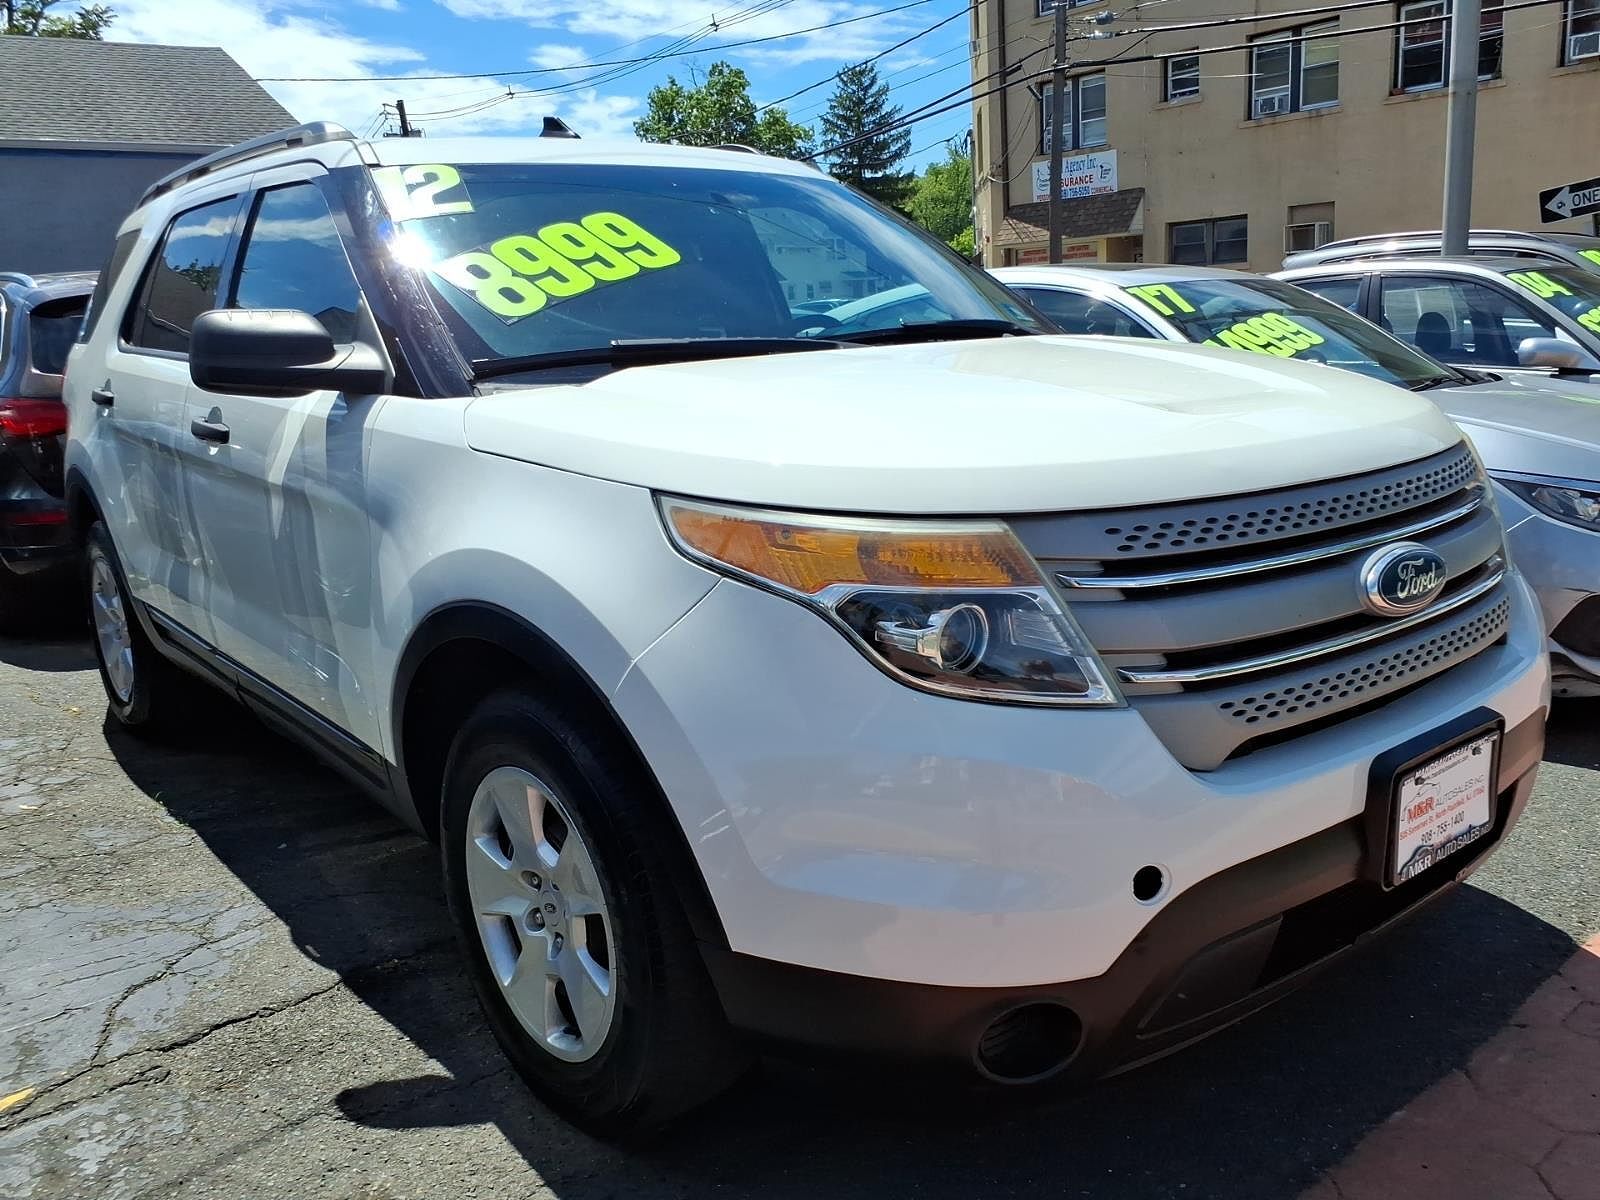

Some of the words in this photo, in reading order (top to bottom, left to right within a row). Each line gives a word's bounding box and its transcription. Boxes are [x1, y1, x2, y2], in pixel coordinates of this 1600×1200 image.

[1064, 158, 1086, 176] Agency
[1061, 174, 1094, 187] SURANCE
[1572, 188, 1600, 207] ONE
[437, 212, 681, 317] 8999
[1507, 270, 1573, 298] 04
[1203, 312, 1325, 357] 4999
[1397, 557, 1441, 599] Ford
[1408, 854, 1432, 879] M&R
